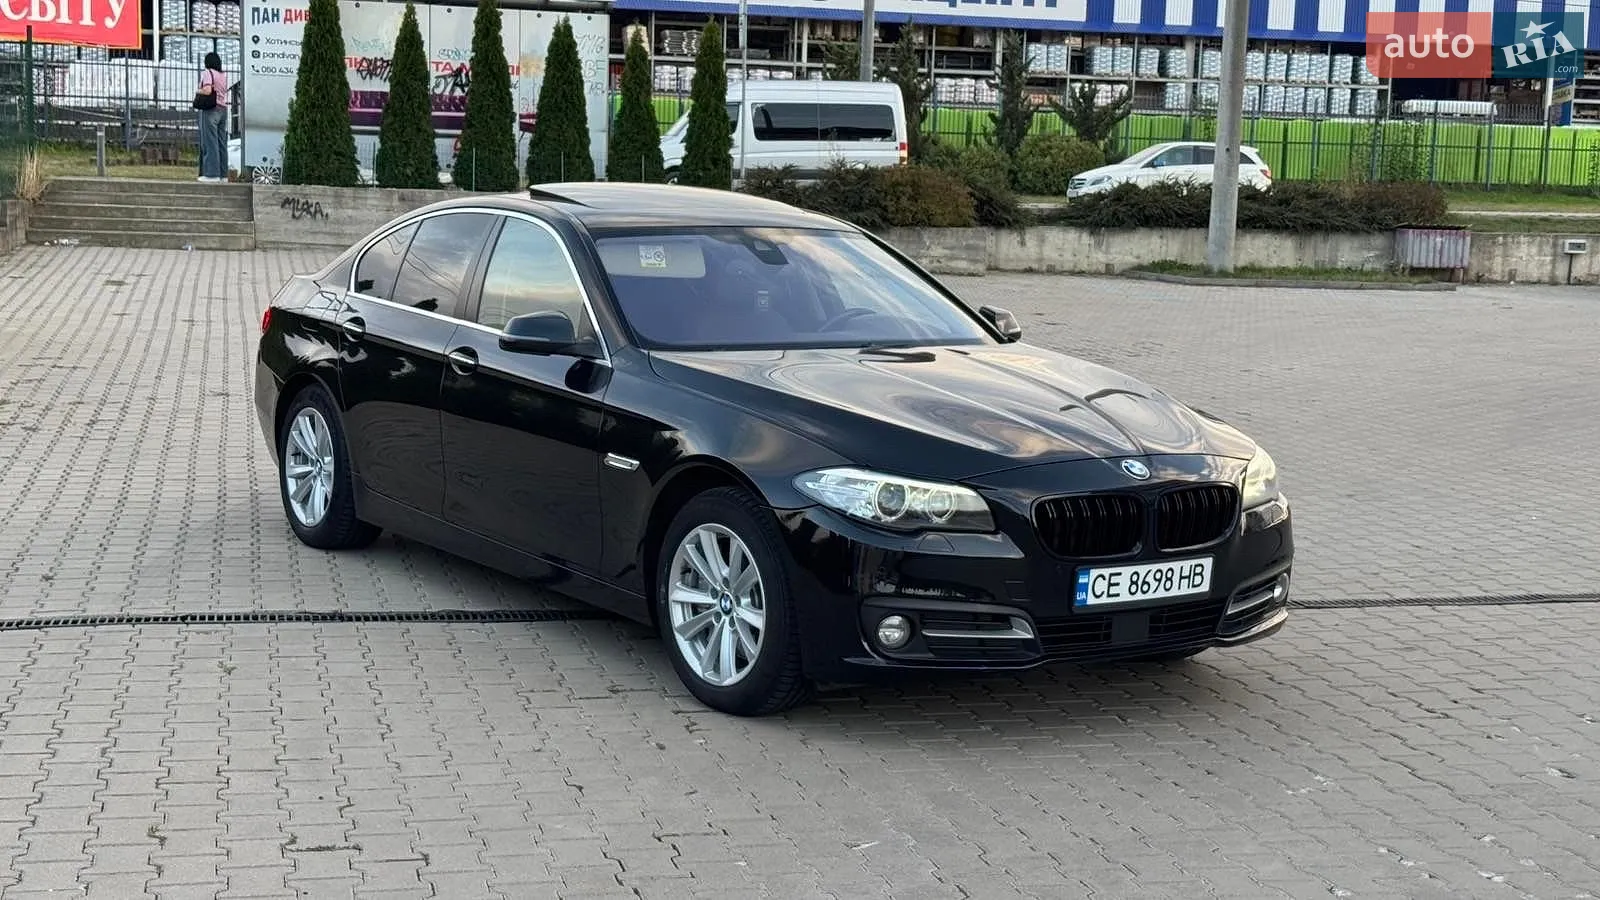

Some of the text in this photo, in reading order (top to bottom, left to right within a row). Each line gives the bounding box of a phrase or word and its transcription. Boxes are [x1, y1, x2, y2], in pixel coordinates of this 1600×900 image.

[251, 7, 280, 25] ПАН
[1091, 563, 1205, 599] CE 8698 HB
[1076, 591, 1087, 601] UA
